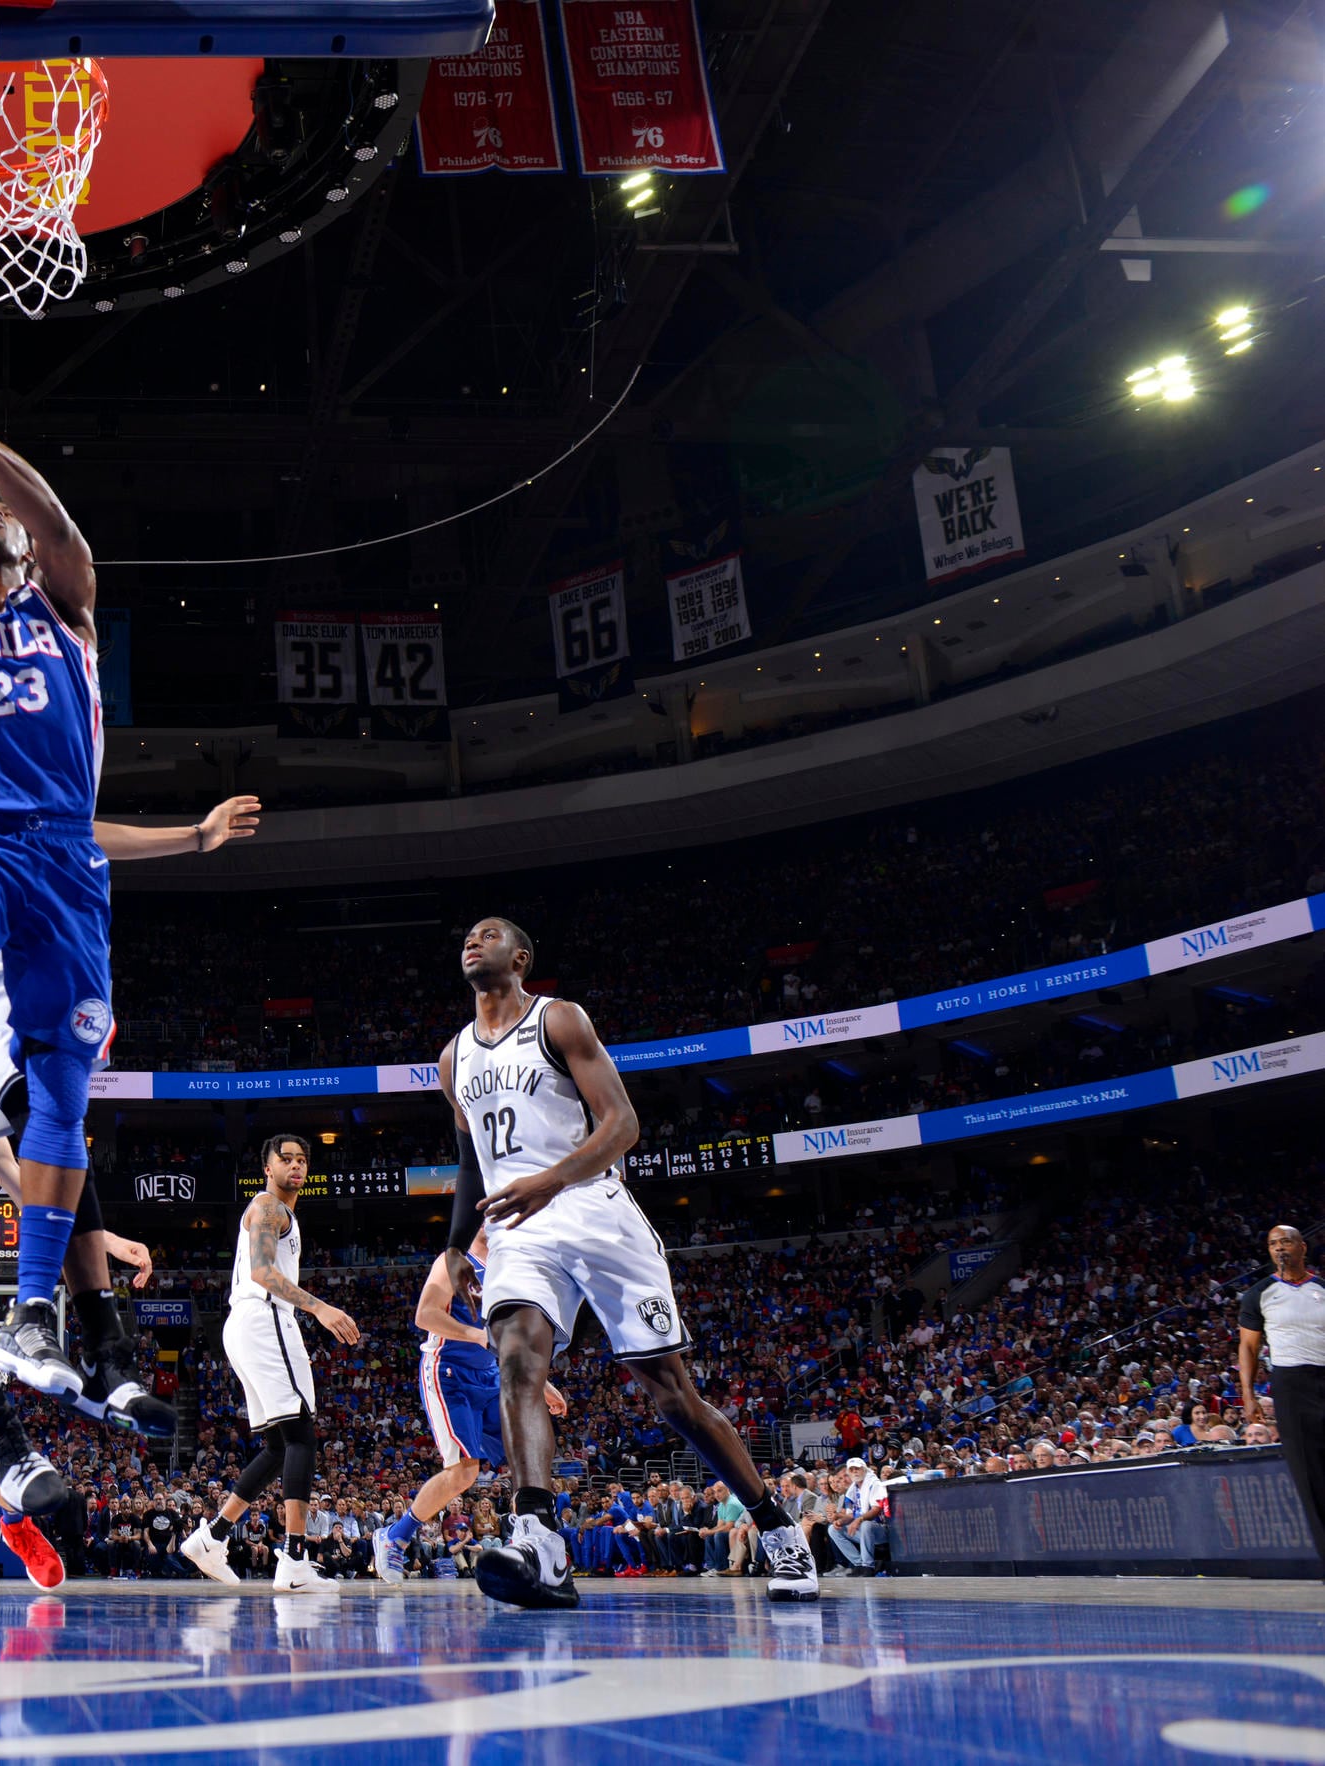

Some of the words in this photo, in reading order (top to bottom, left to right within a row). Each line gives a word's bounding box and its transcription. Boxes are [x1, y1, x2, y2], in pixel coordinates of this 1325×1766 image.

[613, 10, 645, 26] NBA
[598, 27, 665, 43] EASTERN
[589, 43, 682, 61] CONFERENCE
[438, 61, 524, 78] CHAMPIONS
[595, 61, 681, 78] CHAMPIONS
[453, 90, 514, 109] 1976-77
[610, 90, 674, 107] 1966-67
[472, 126, 504, 149] 76
[631, 126, 666, 148] 76
[438, 152, 510, 166] Philadelphia
[512, 156, 545, 165] 76ers
[598, 153, 672, 166] Philadelphia
[674, 154, 706, 164] 76ers
[933, 476, 998, 518] WE'RE
[941, 504, 997, 545] BACK
[933, 551, 964, 569] Where
[964, 544, 980, 559] We
[980, 536, 1014, 554] Belong
[282, 624, 319, 639] DALLAS
[366, 627, 386, 639] TOM
[562, 596, 619, 669] 66
[291, 641, 342, 698] 35
[376, 643, 439, 700] 42
[1180, 925, 1228, 957] NJM
[935, 996, 971, 1012] AUTO
[988, 983, 1028, 1001] HOME
[1045, 966, 1108, 988] RENTERS
[825, 1014, 862, 1026] Insurance
[783, 1018, 827, 1044] NJM
[825, 1025, 851, 1036] Group
[1211, 1051, 1262, 1082] NJM
[188, 1081, 221, 1090] AUTO
[237, 1080, 272, 1089] HOME
[287, 1077, 341, 1088] RENTERS
[963, 1114, 986, 1125] This
[1009, 1106, 1028, 1119] just
[483, 1106, 523, 1161] 22
[847, 1126, 883, 1136] Insurance
[803, 1129, 847, 1154] NJM
[847, 1137, 871, 1146] Group
[629, 1154, 662, 1166] 8:54
[673, 1153, 692, 1164] PHI
[700, 1151, 713, 1160] 21
[720, 1148, 732, 1157] 13
[332, 1174, 343, 1182] 12
[361, 1173, 373, 1181] 31
[376, 1172, 388, 1181] 22
[639, 1168, 653, 1176] PM
[672, 1164, 696, 1176] BKN
[702, 1162, 715, 1171] 12
[140, 1175, 192, 1198] NETS
[141, 1303, 183, 1312] GEICO
[640, 1299, 671, 1318] NETS
[136, 1315, 153, 1325] 107
[171, 1315, 189, 1325] 106
[1045, 1488, 1175, 1552] NBAStore.com
